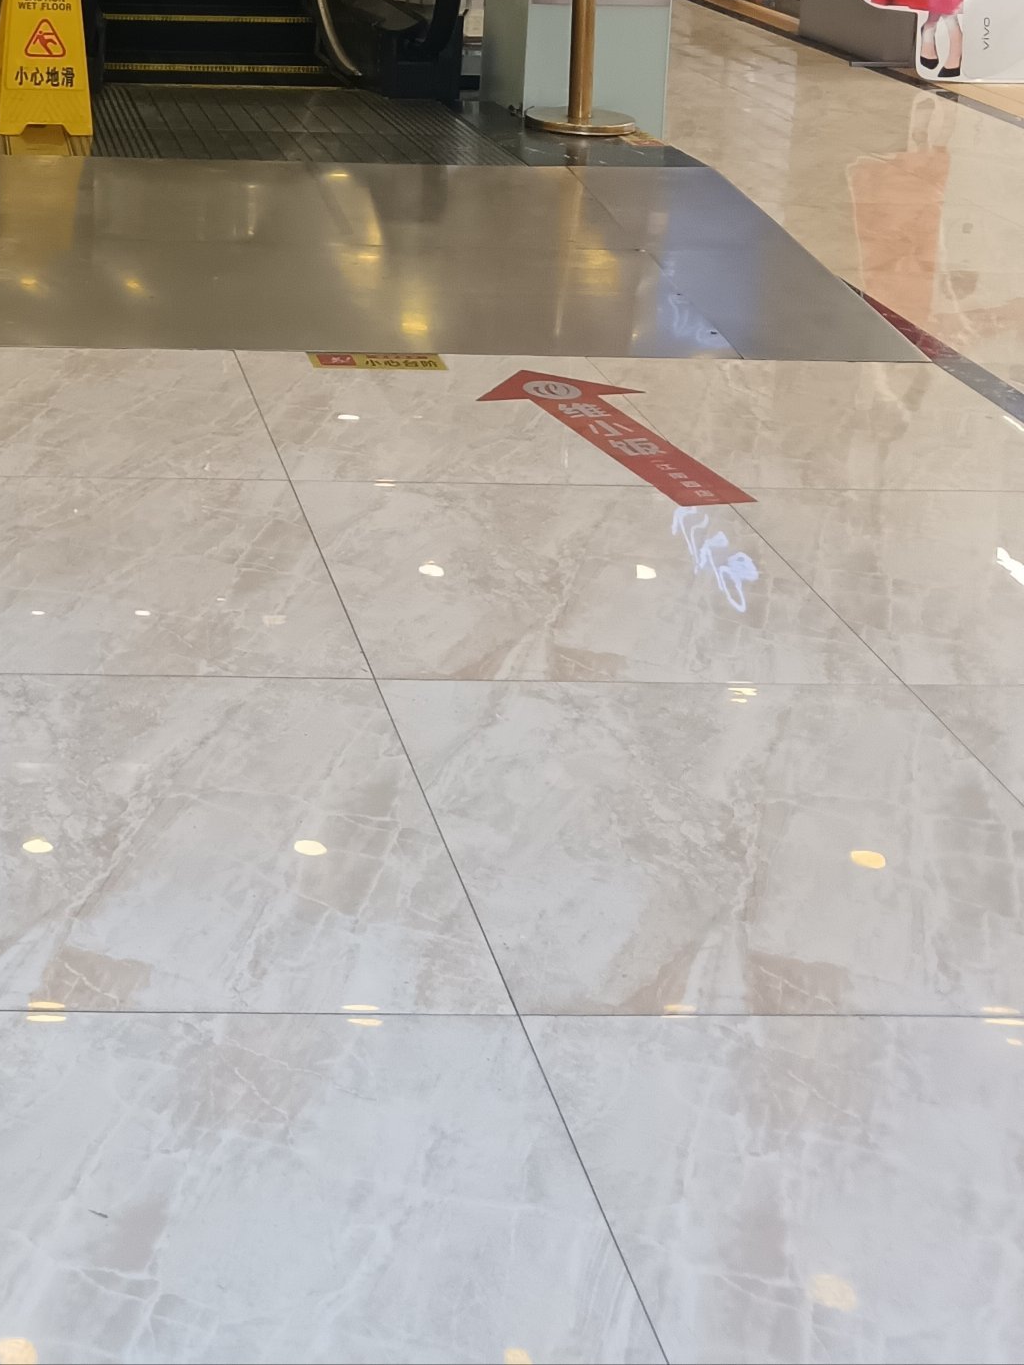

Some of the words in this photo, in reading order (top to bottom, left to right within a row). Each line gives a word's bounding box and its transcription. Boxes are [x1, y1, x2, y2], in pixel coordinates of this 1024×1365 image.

[18, 1, 37, 11] WET
[41, 2, 72, 12] FLOOR
[14, 66, 75, 87] 小心地滑
